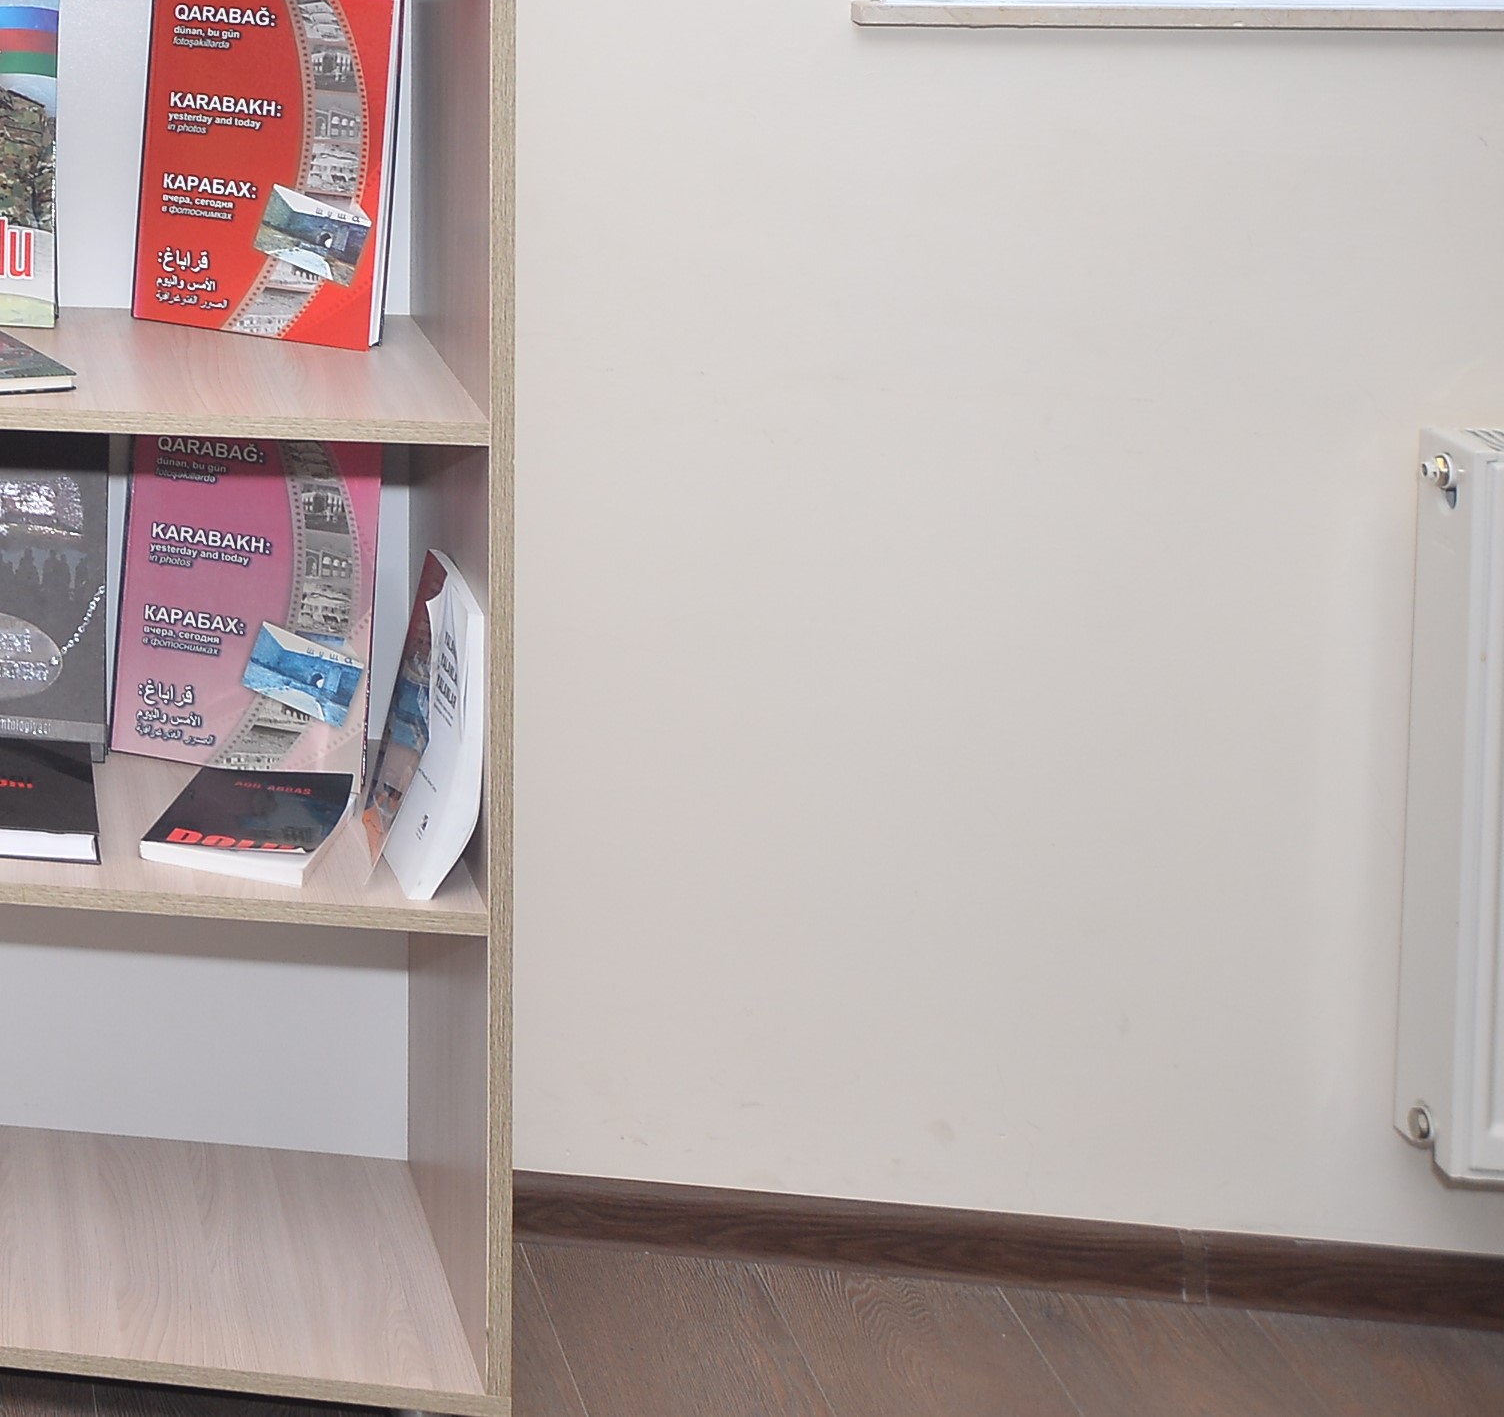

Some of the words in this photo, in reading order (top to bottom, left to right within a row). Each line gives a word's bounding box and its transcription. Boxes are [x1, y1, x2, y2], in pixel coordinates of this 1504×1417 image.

[174, 3, 277, 27] QARABAĞ:
[169, 91, 282, 118] KARABAKH:
[162, 173, 258, 199] КАРАБАХ:
